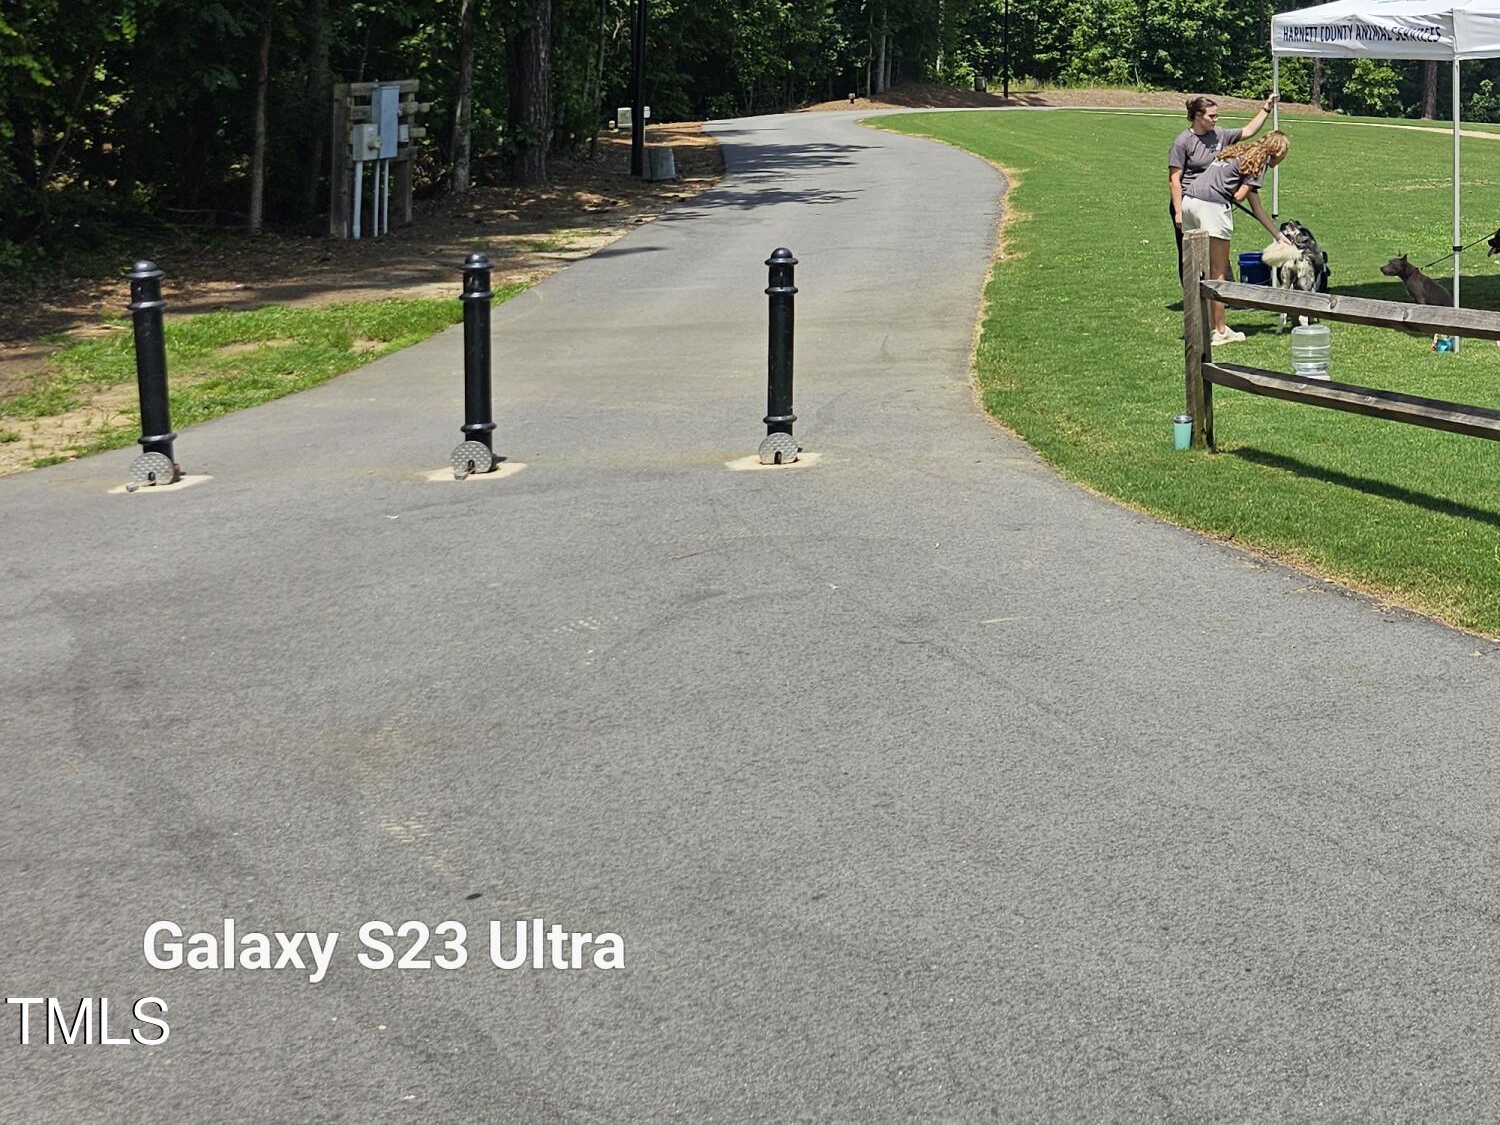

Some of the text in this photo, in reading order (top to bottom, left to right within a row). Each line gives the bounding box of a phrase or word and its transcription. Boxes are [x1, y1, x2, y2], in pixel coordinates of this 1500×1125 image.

[1283, 26, 1317, 43] HARNETT
[1320, 25, 1353, 42] COUNTY
[1355, 25, 1392, 42] ANIMAL
